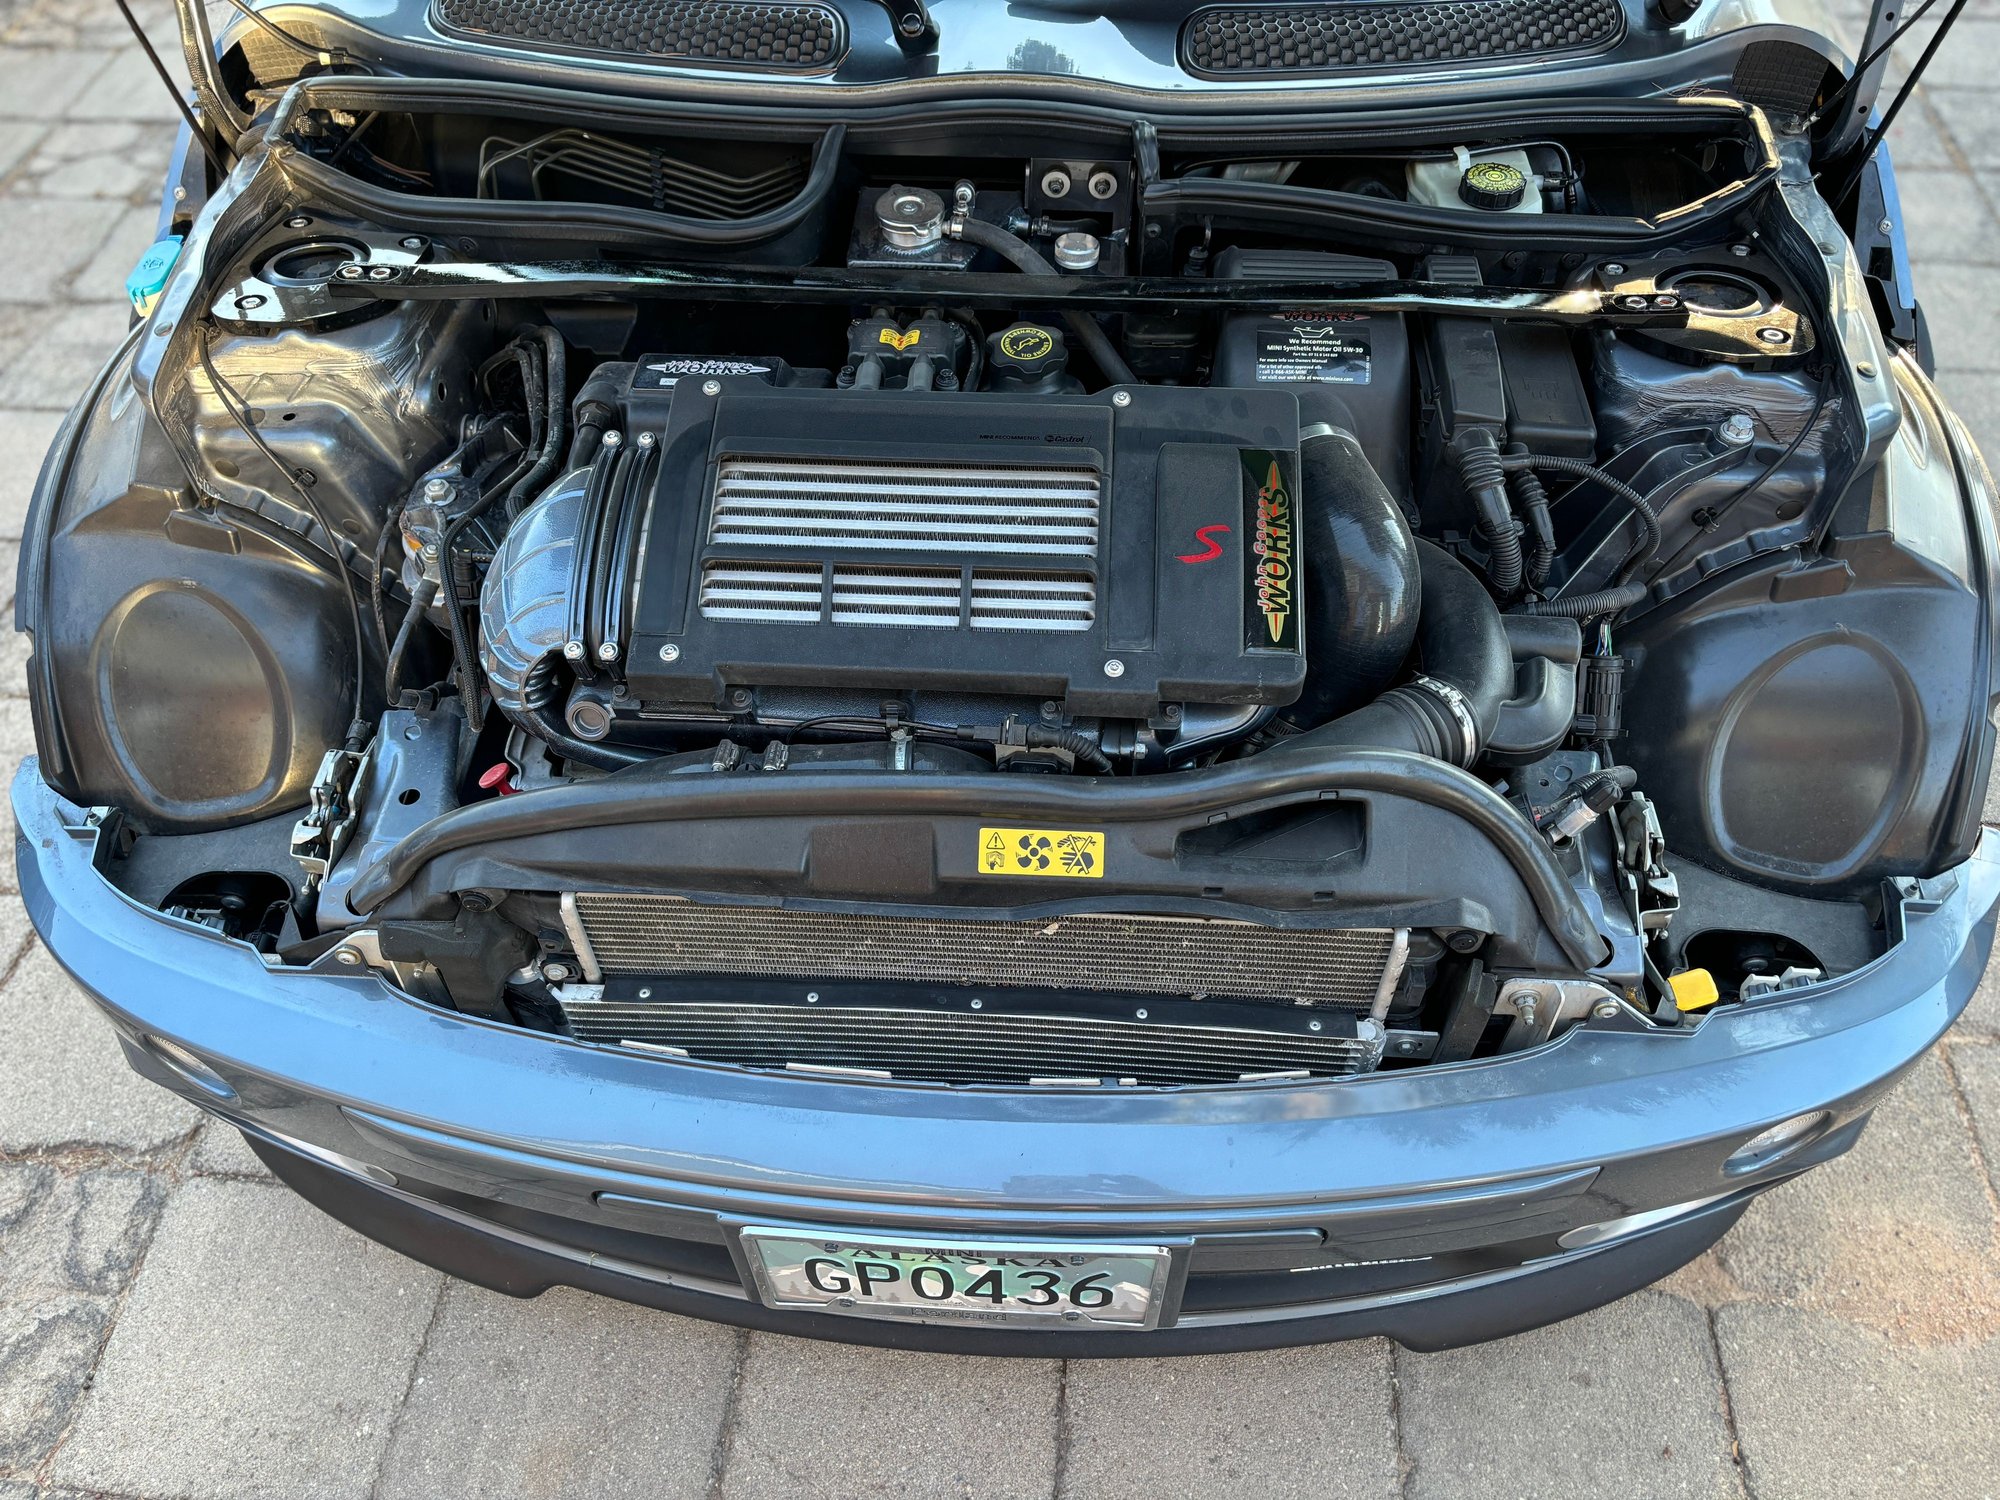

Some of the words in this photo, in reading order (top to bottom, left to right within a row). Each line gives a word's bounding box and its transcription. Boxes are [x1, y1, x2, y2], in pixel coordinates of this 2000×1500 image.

[1283, 345, 1312, 353] Synthetic
[663, 361, 752, 375] WORKS
[1054, 435, 1085, 443] Castrol
[1253, 486, 1271, 555] Cooper
[1174, 524, 1232, 564] S
[1262, 487, 1292, 615] WORKS
[1255, 565, 1271, 611] John
[851, 1249, 1067, 1268] ALASKA
[924, 1247, 983, 1257] MINI
